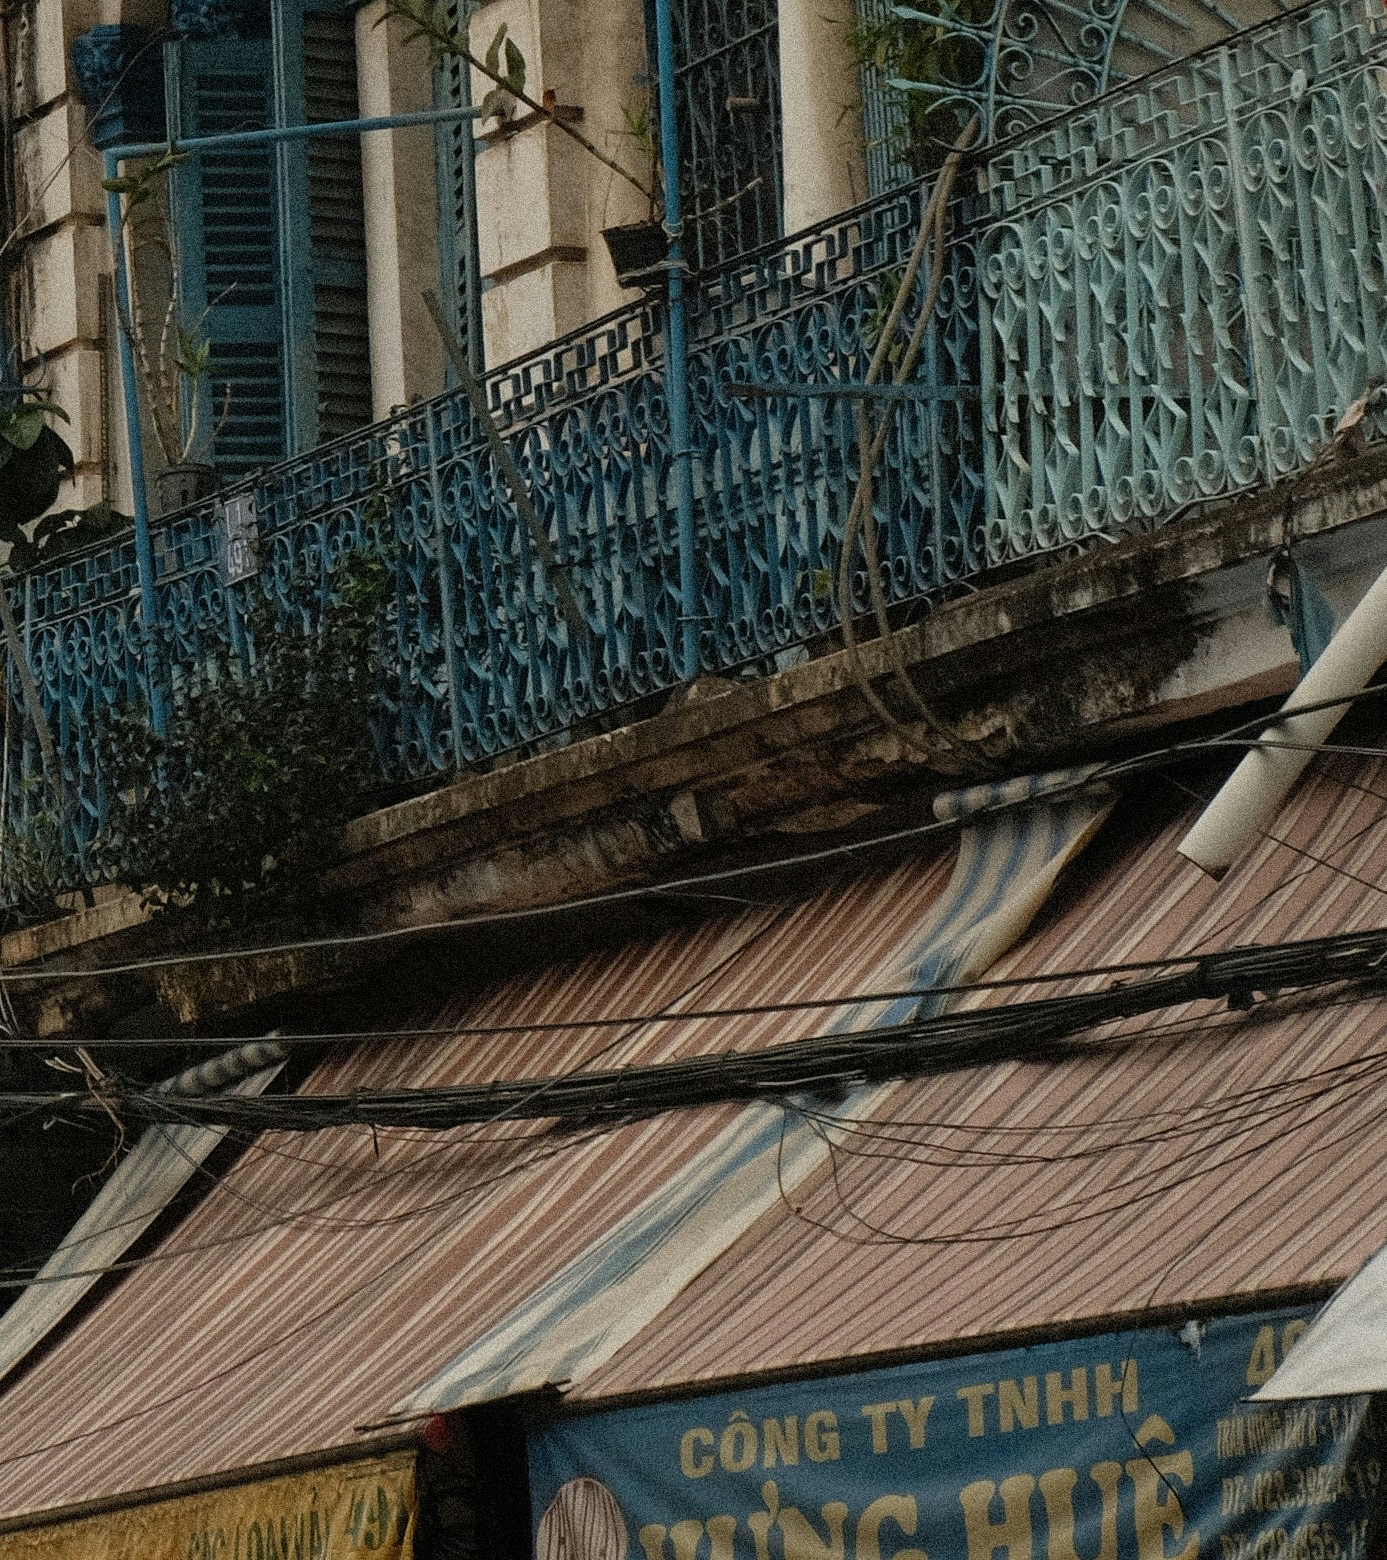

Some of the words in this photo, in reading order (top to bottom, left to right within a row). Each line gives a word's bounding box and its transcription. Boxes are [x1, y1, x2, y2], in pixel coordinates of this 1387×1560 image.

[680, 1411, 841, 1480] CÔNG
[862, 1395, 937, 1455] TY
[957, 1359, 1139, 1439] TNHH
